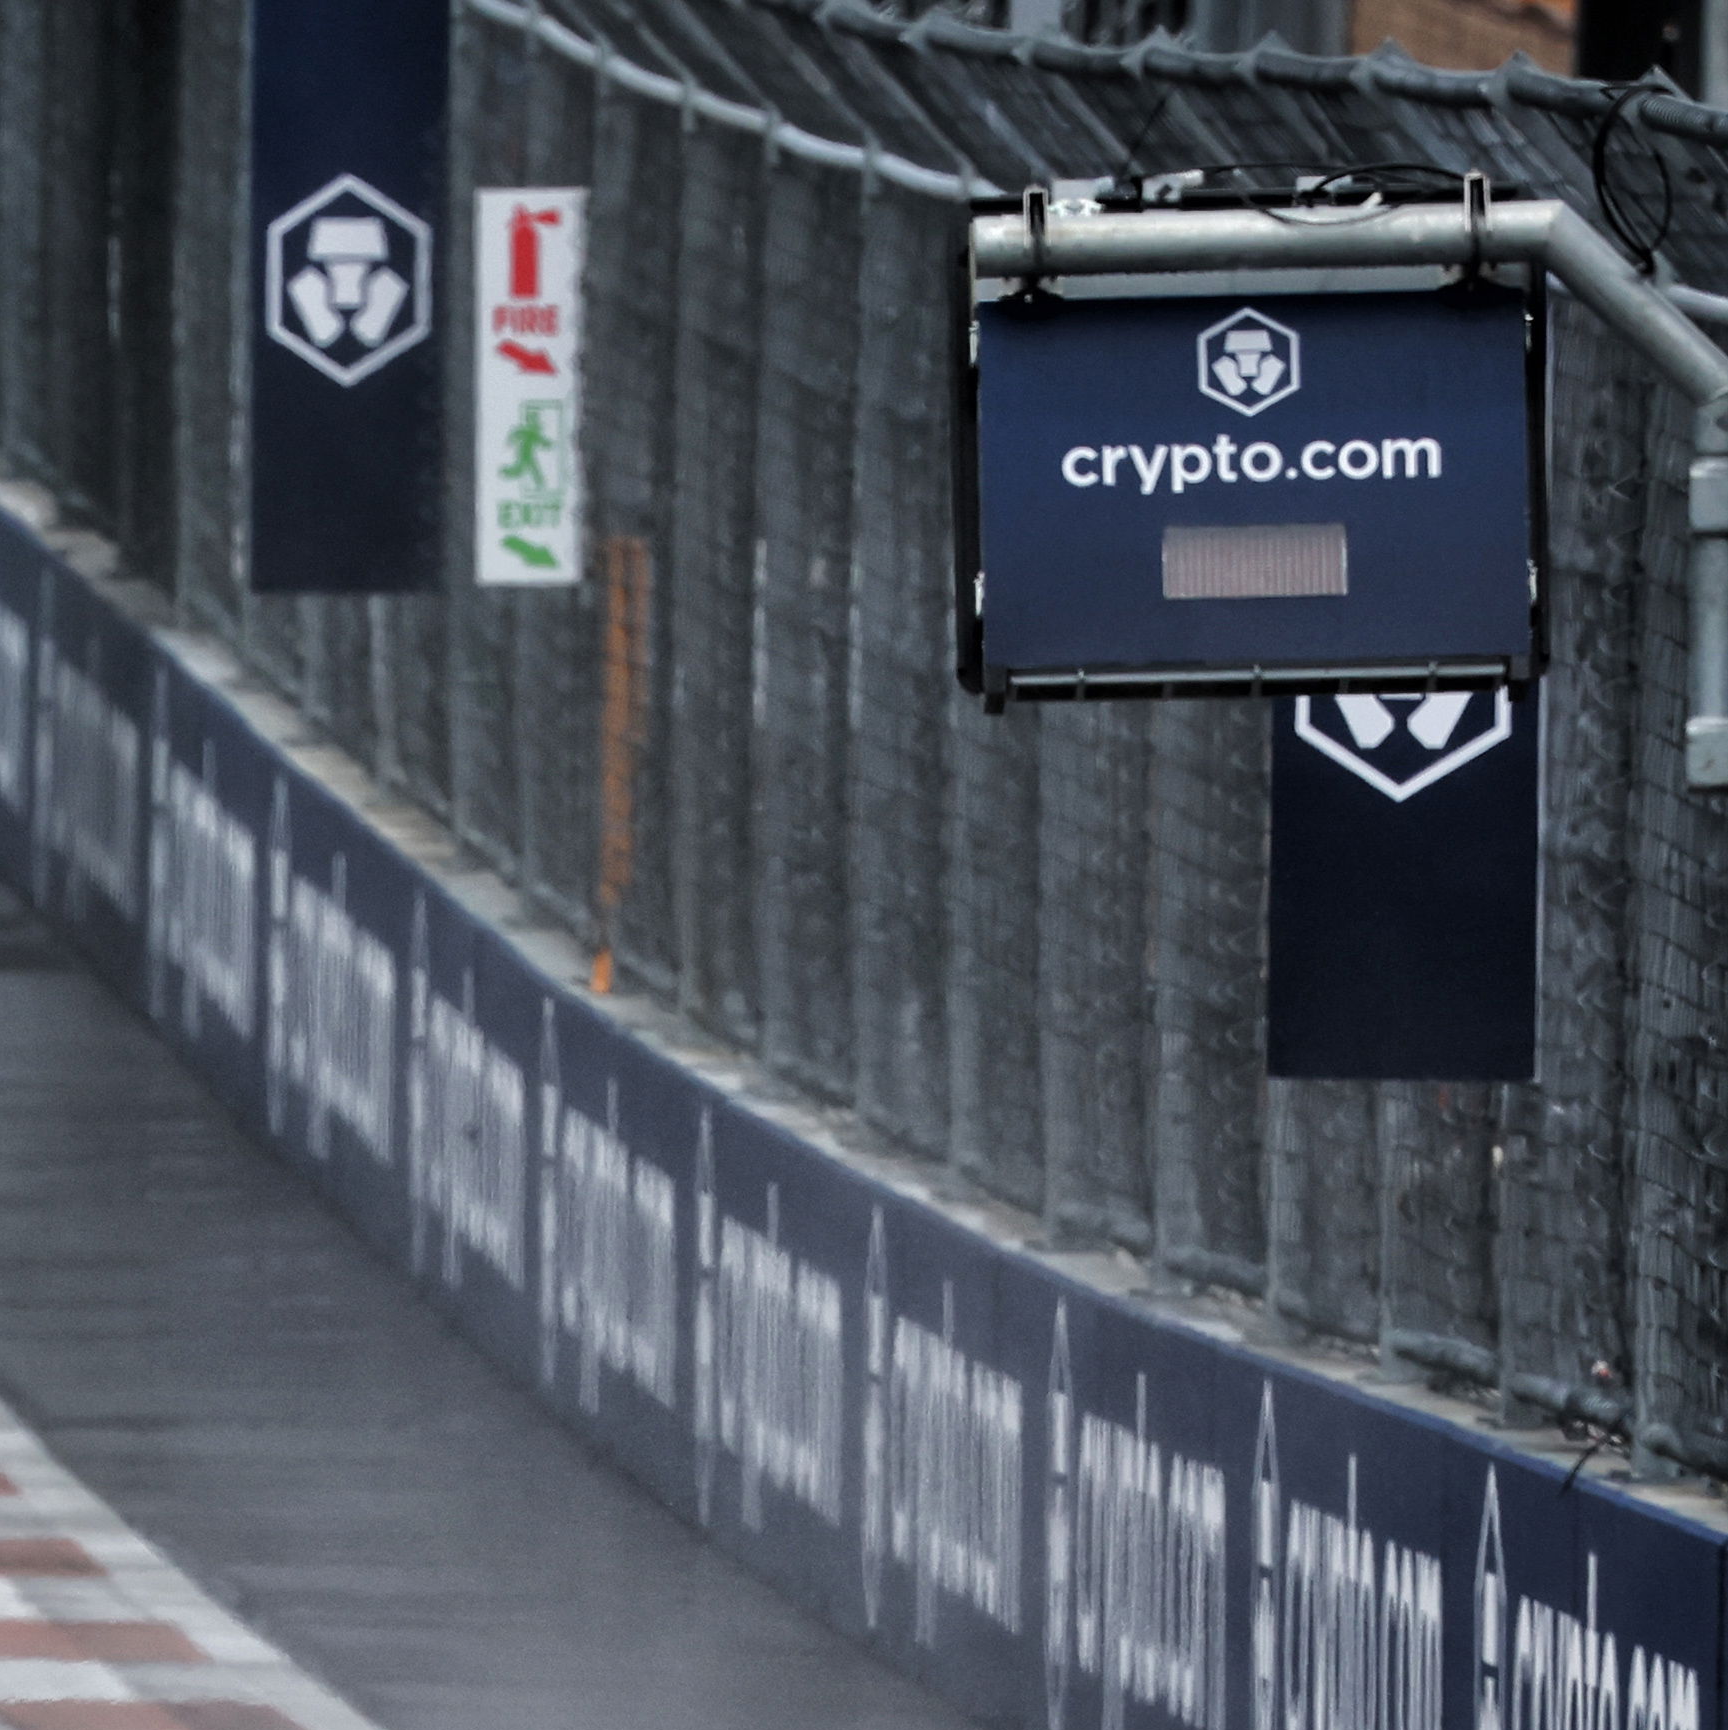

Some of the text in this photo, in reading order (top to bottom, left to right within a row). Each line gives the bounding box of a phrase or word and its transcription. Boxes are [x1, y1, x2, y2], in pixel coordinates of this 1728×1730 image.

[493, 306, 559, 336] FIRE
[1061, 434, 1442, 495] crypto.com
[497, 501, 561, 529] EXIT
